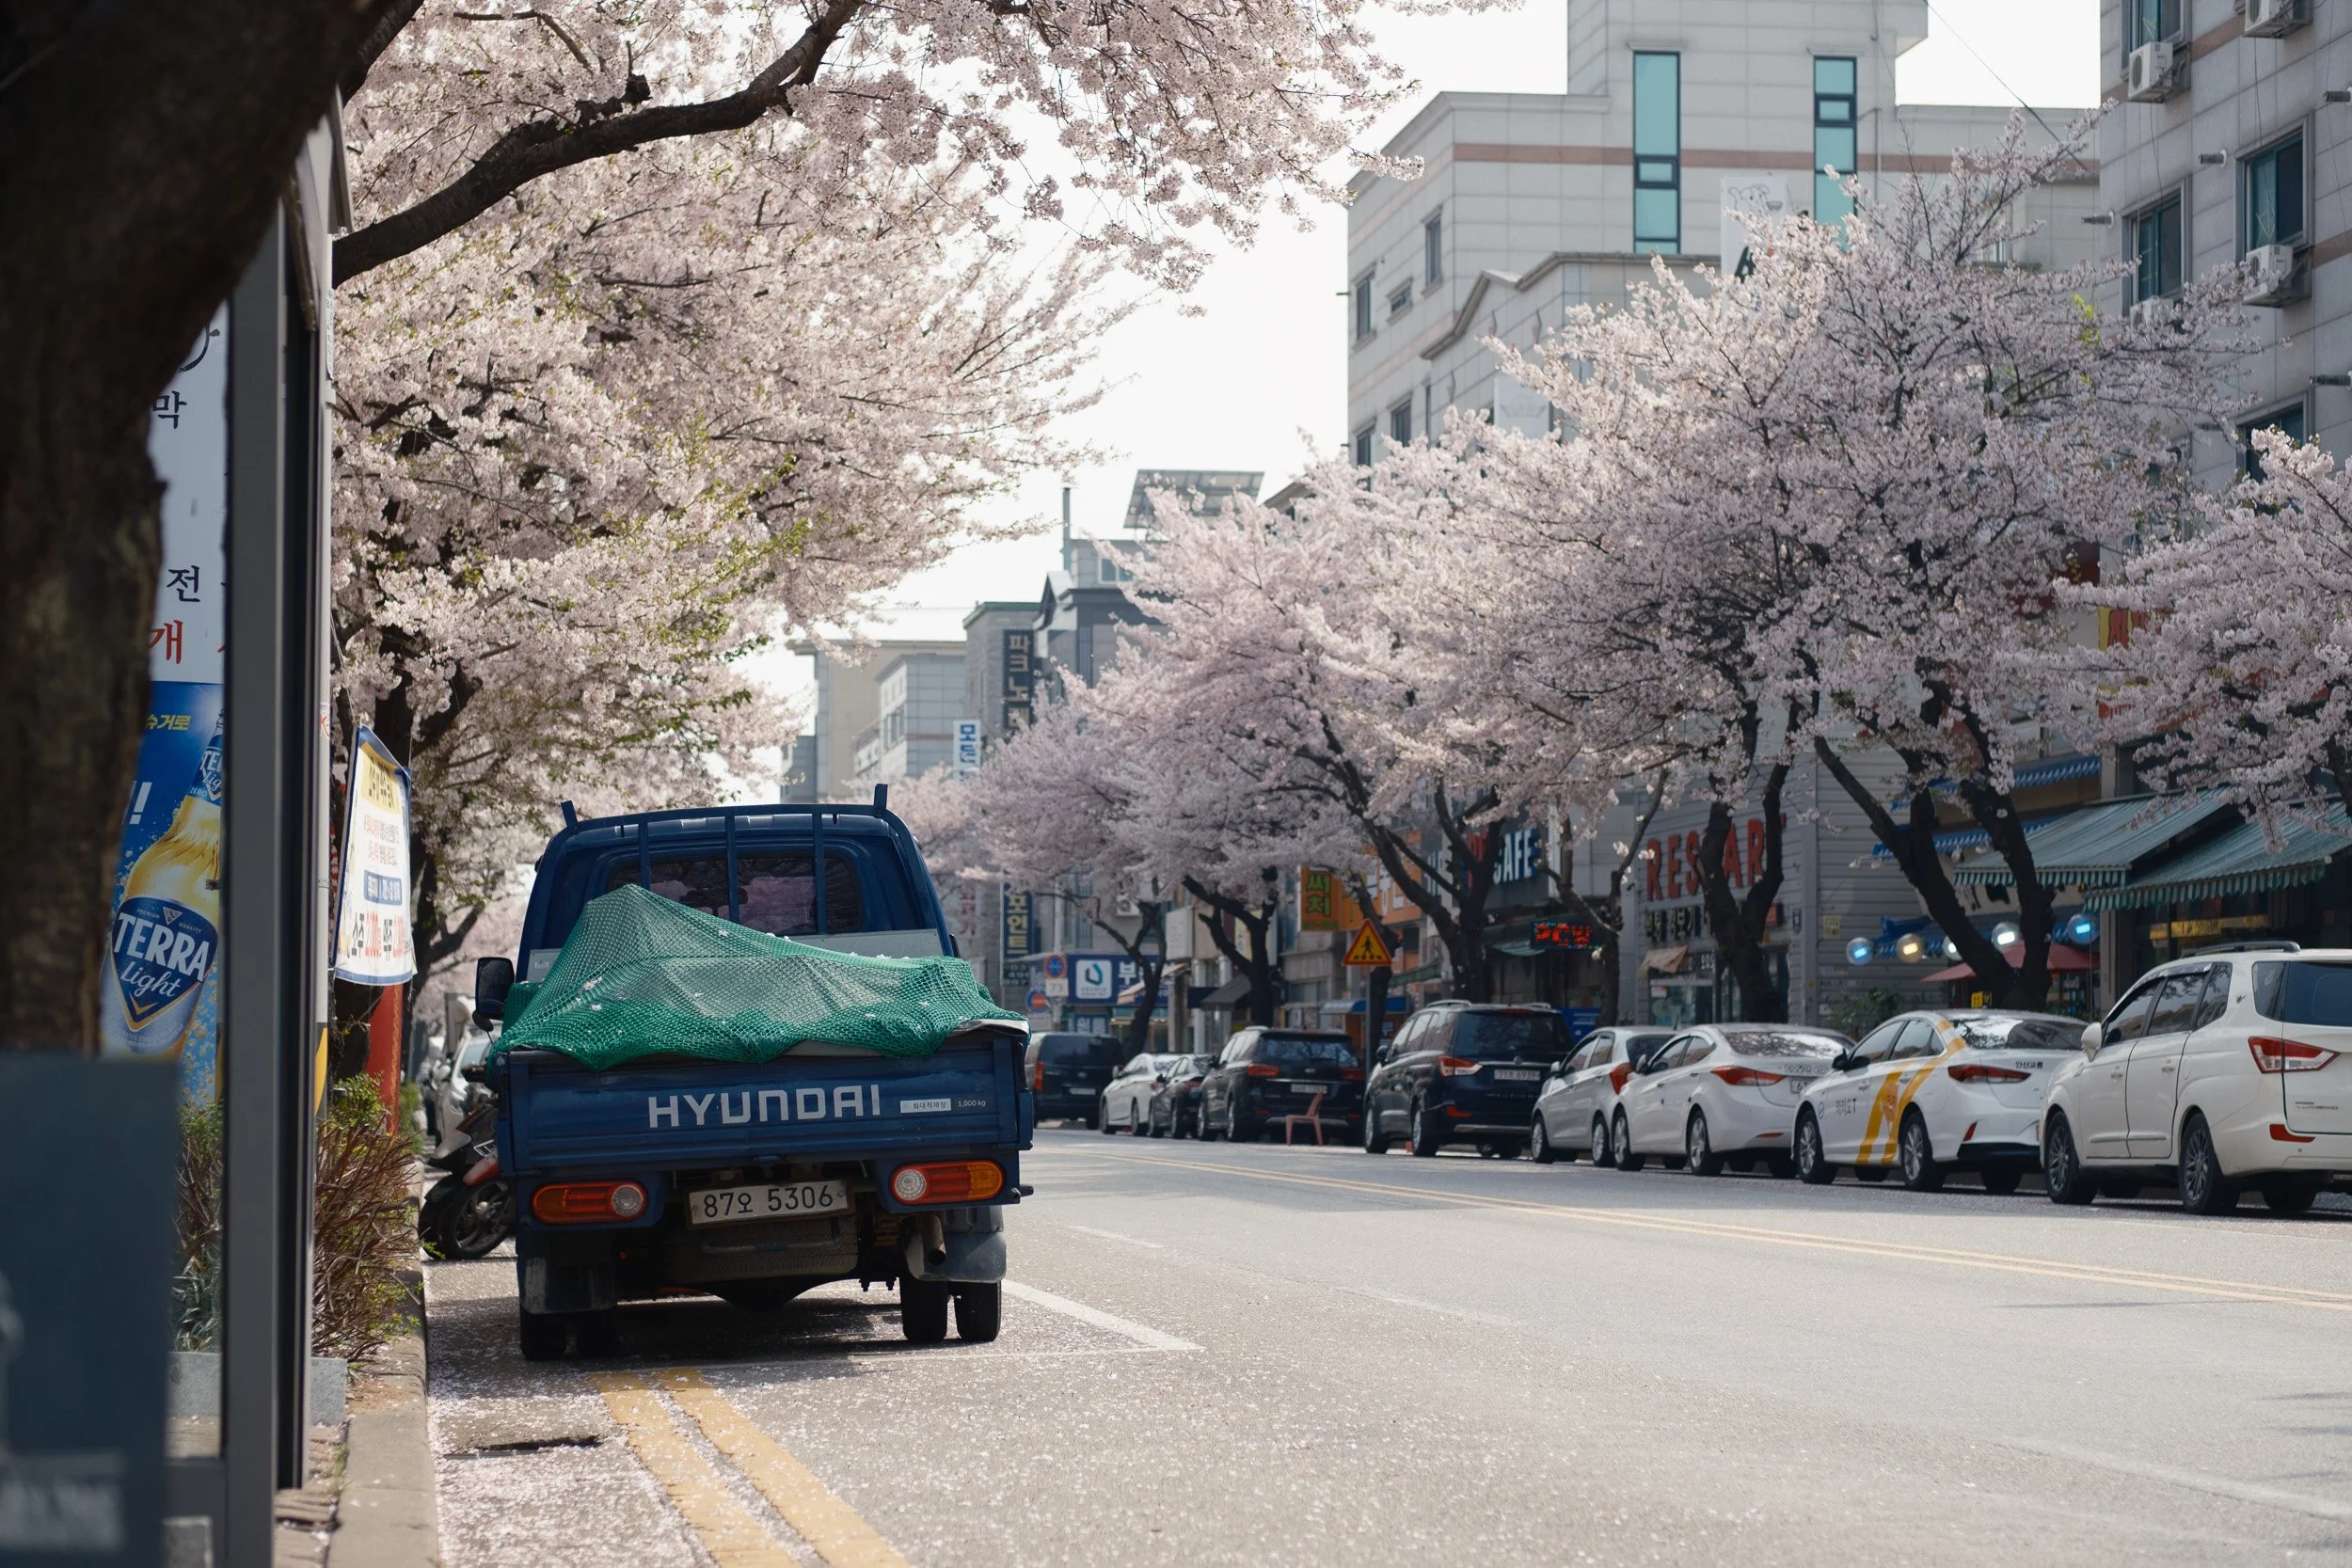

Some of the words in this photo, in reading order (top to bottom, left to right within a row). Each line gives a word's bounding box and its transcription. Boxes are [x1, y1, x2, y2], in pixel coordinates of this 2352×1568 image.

[114, 912, 210, 982] TERRA
[119, 961, 183, 998] Light
[648, 1084, 881, 1129] HYUNDAI
[958, 1100, 977, 1108] 1,000
[977, 1099, 987, 1107] kg
[703, 1191, 754, 1219] 87오
[767, 1184, 834, 1212] 5306
